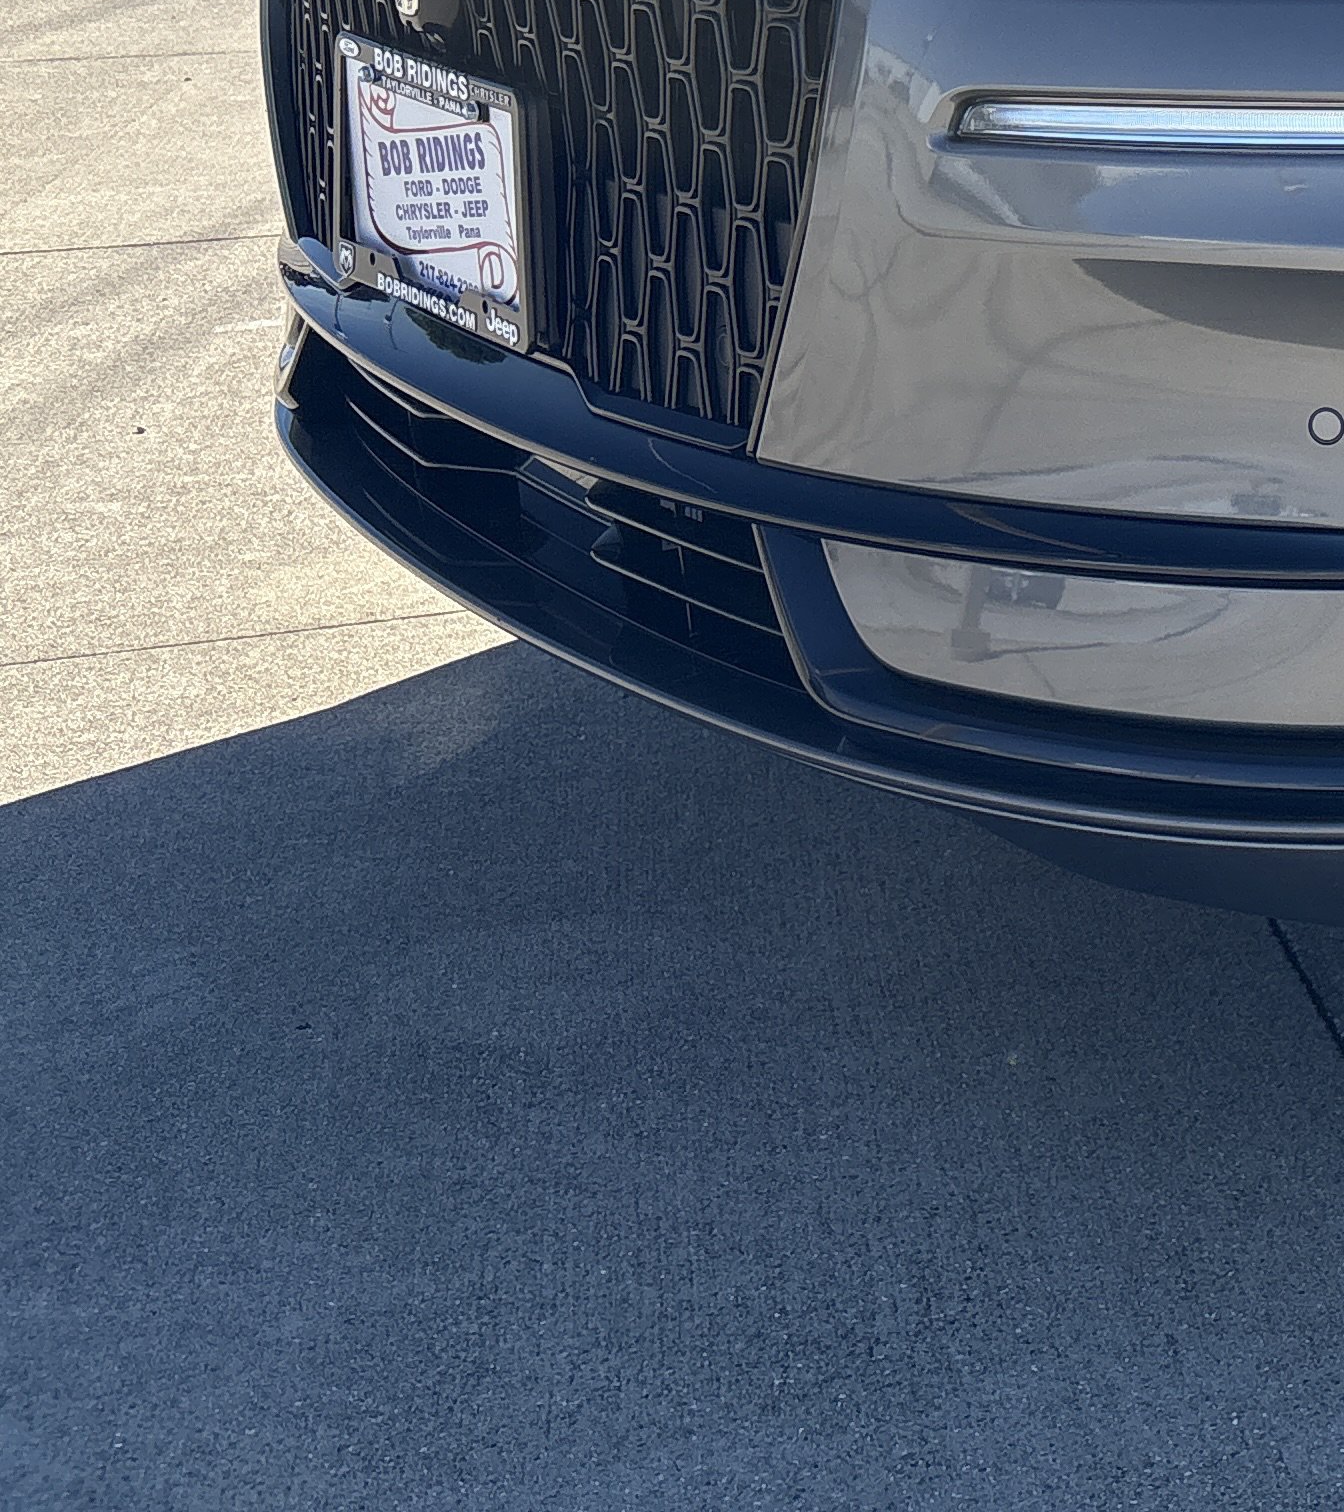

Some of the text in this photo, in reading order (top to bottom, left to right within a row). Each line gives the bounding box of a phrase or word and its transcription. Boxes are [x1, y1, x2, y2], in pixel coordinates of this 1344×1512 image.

[373, 47, 470, 101] BOB RIDINGS
[381, 76, 433, 104] TAYLORVILLE
[438, 96, 462, 114] PANA
[469, 84, 512, 107] CHRYSLER
[378, 132, 486, 176] BOB RIDINGS
[403, 179, 434, 198] FORD
[441, 176, 483, 196] DODGE
[395, 201, 453, 221] CHRYSLER
[461, 199, 489, 218] JEEP
[406, 224, 482, 244] Taylorville Pana
[418, 259, 479, 295] 217-824-22
[376, 272, 477, 331] BOBRIDINGS.COM
[486, 307, 518, 347] Jeep
